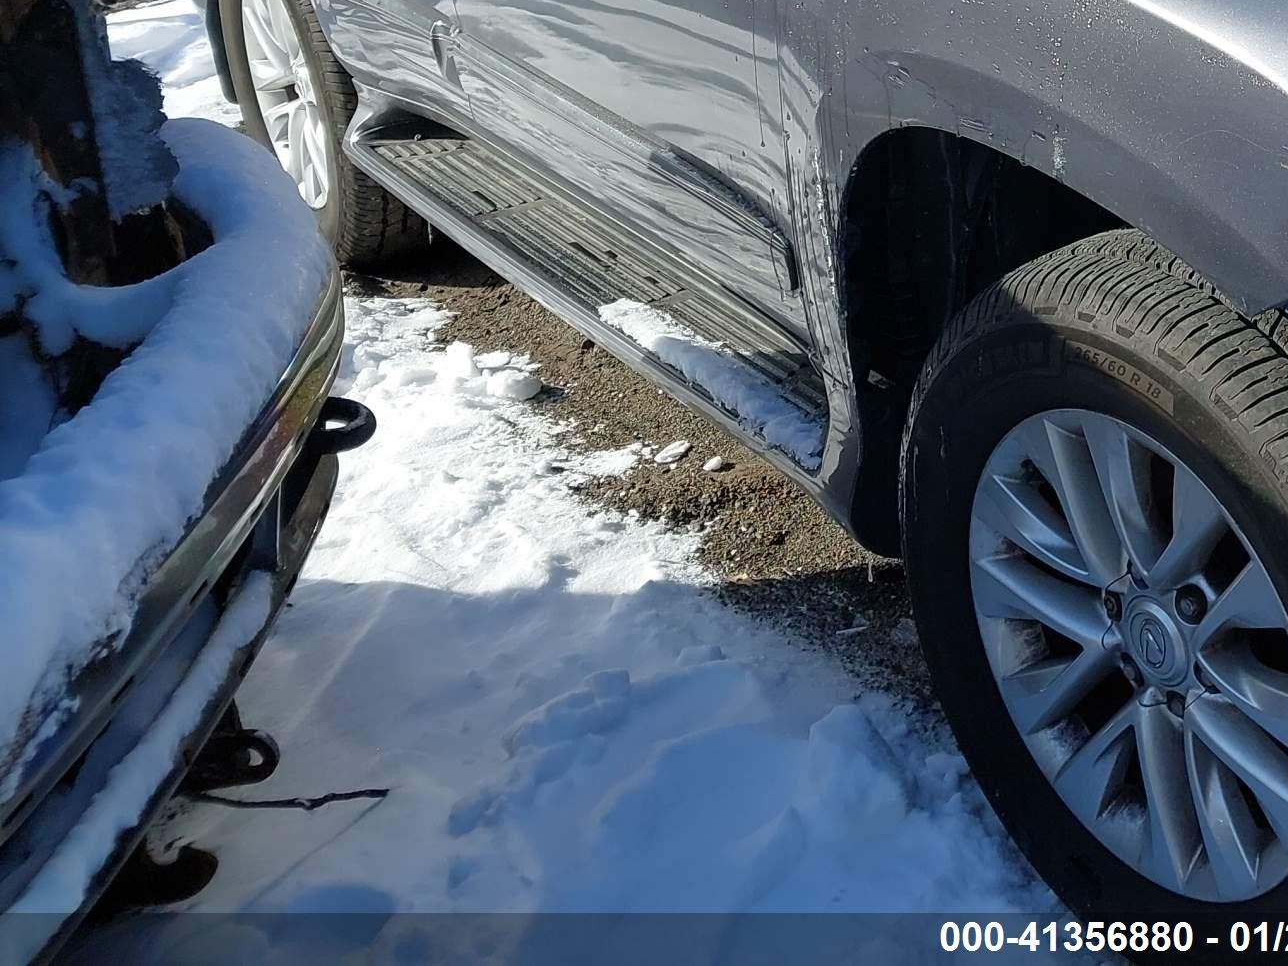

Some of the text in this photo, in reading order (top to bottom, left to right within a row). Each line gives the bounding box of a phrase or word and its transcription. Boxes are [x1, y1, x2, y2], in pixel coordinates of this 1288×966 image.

[1072, 347, 1162, 399] 265/60 R 18
